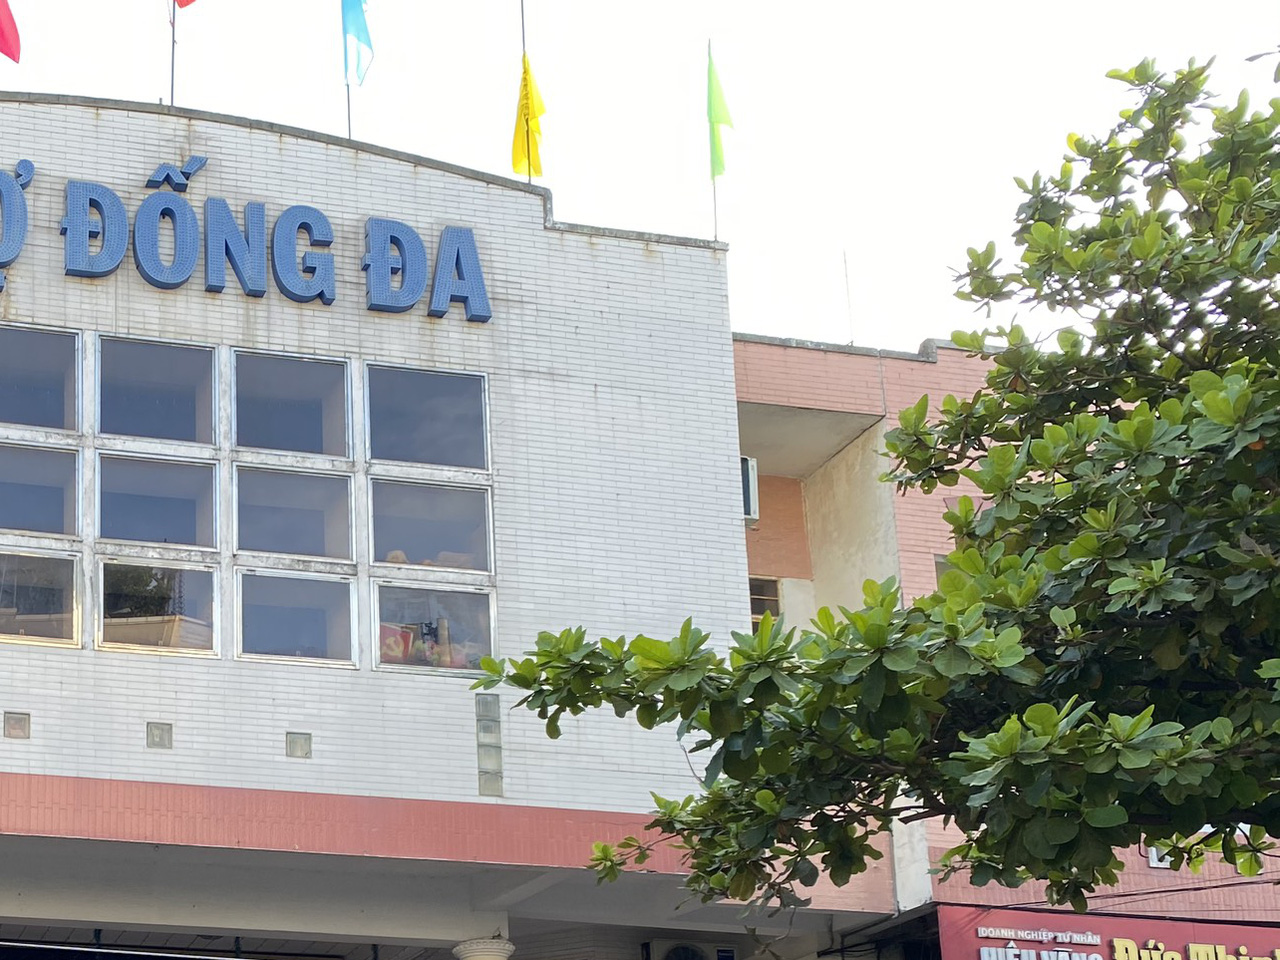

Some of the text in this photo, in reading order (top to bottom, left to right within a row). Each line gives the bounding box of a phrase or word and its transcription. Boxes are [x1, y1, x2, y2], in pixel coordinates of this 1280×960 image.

[60, 155, 336, 306] ĐỐNG
[361, 216, 492, 323] ĐA
[978, 927, 1101, 945] DOANH NGHIỆP TƯ NHÂN
